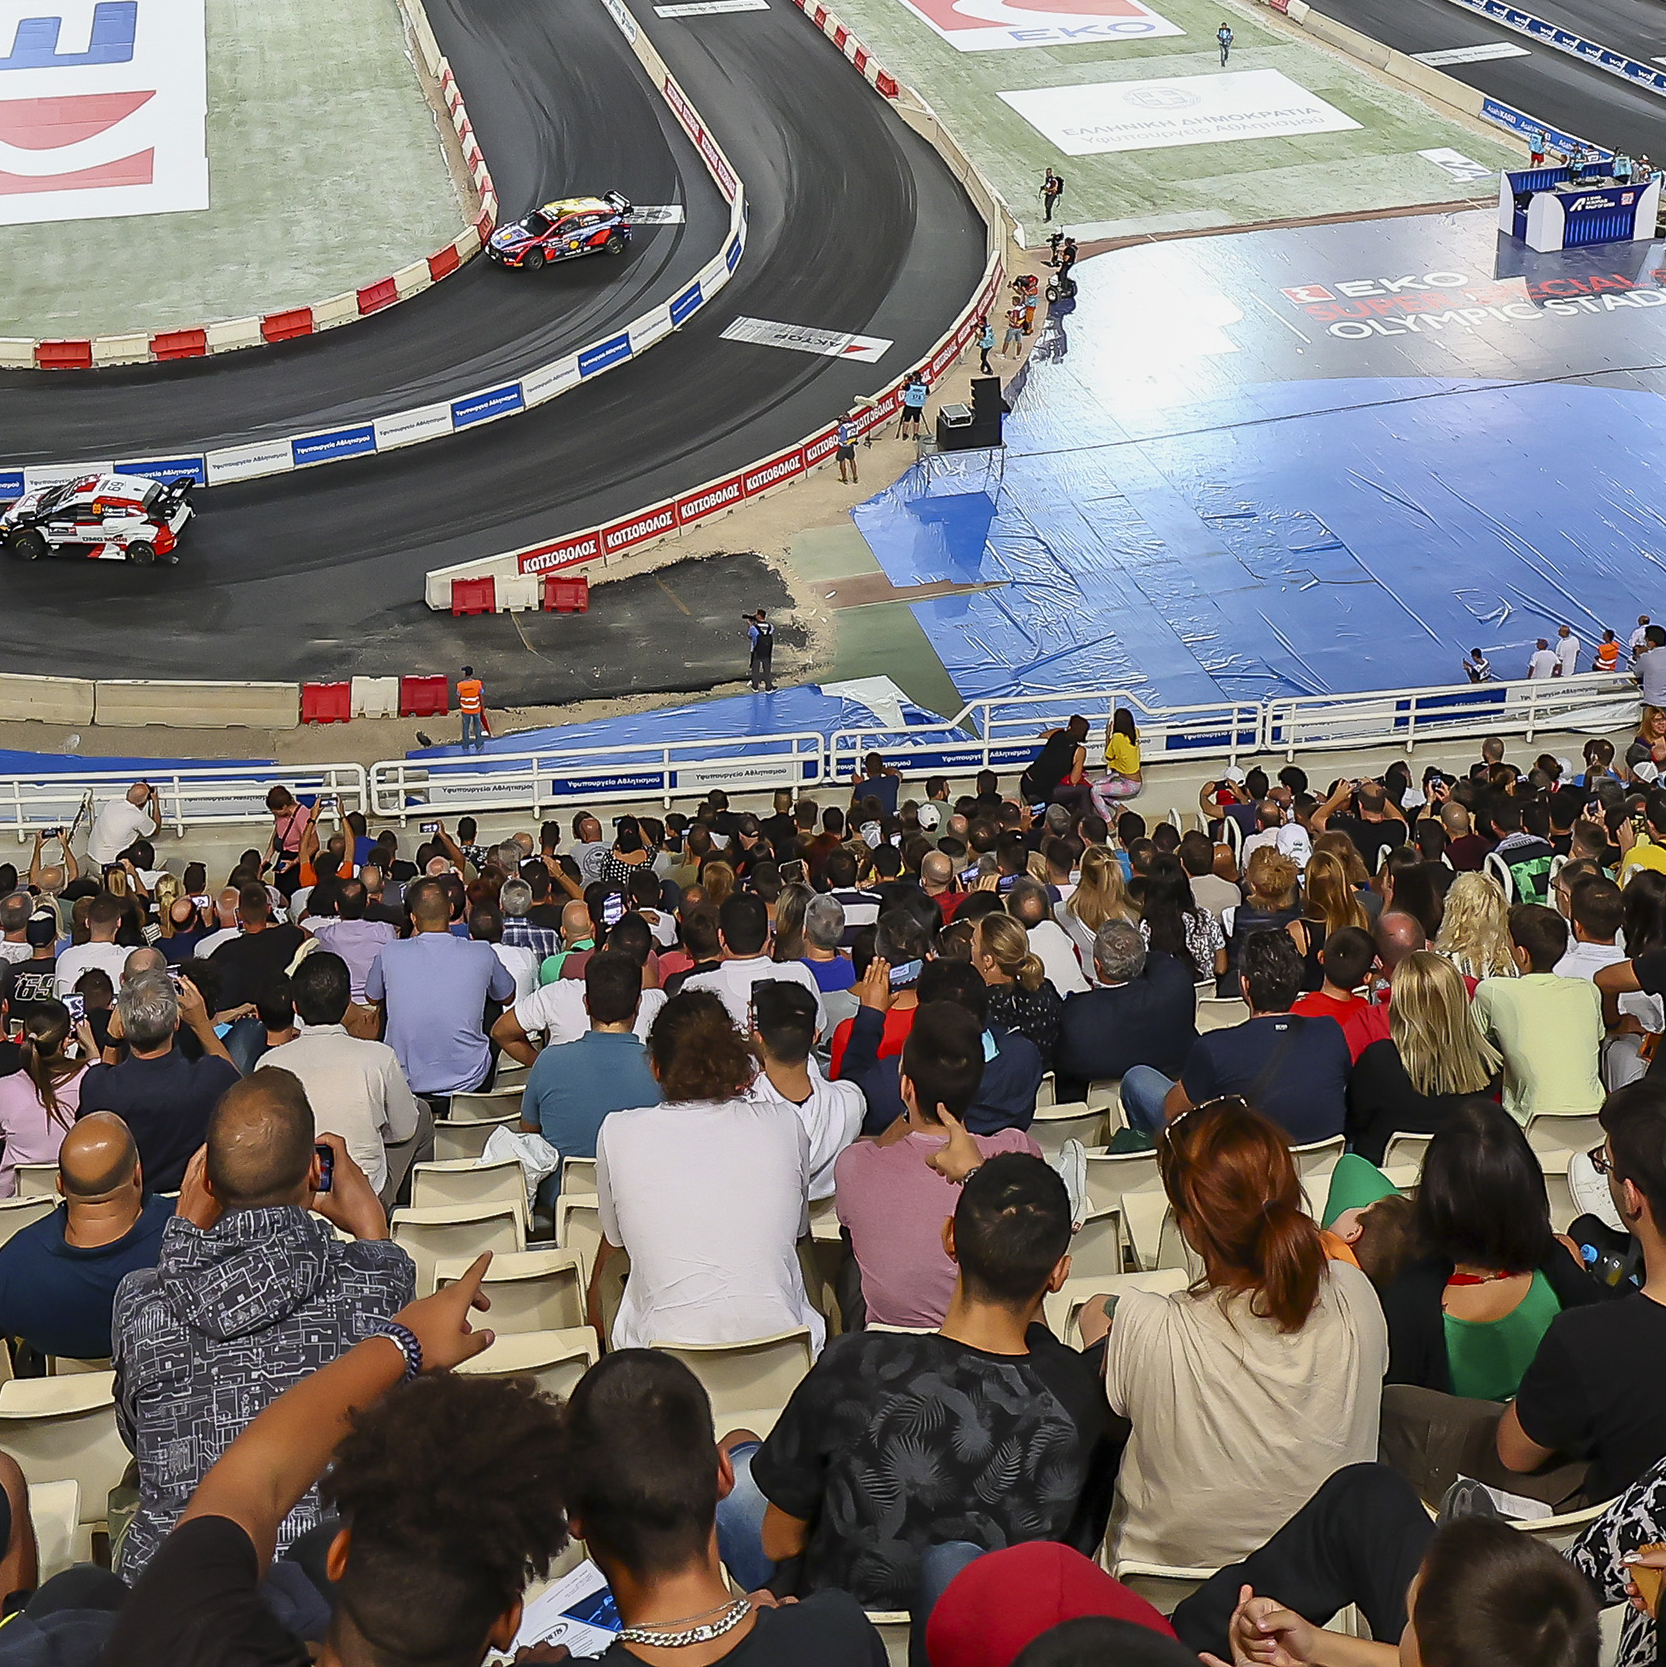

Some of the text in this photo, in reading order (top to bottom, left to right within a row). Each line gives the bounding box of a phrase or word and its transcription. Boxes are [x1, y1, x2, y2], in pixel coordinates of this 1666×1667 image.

[1007, 22, 1156, 41] EKO
[1062, 107, 1321, 136] ΕΛΛΗΝΙΚΗ ΔΗΜΟΚΡΑΤΙΑ
[1334, 271, 1469, 299] EKO
[1326, 300, 1543, 340] OLYMPIC
[297, 435, 370, 454] Υφυπουργείο Αθλητισμού
[163, 467, 199, 476] Αθλητισμού
[523, 457, 801, 573] ΚΩΤΣΟΒΟΛΟΣ ΚΩΤΣΟΒΟΛΟΣ ΚΩΤΣΟΒΟΛΟΣ ΚΩΤΣΟΒΟΛΟΣ
